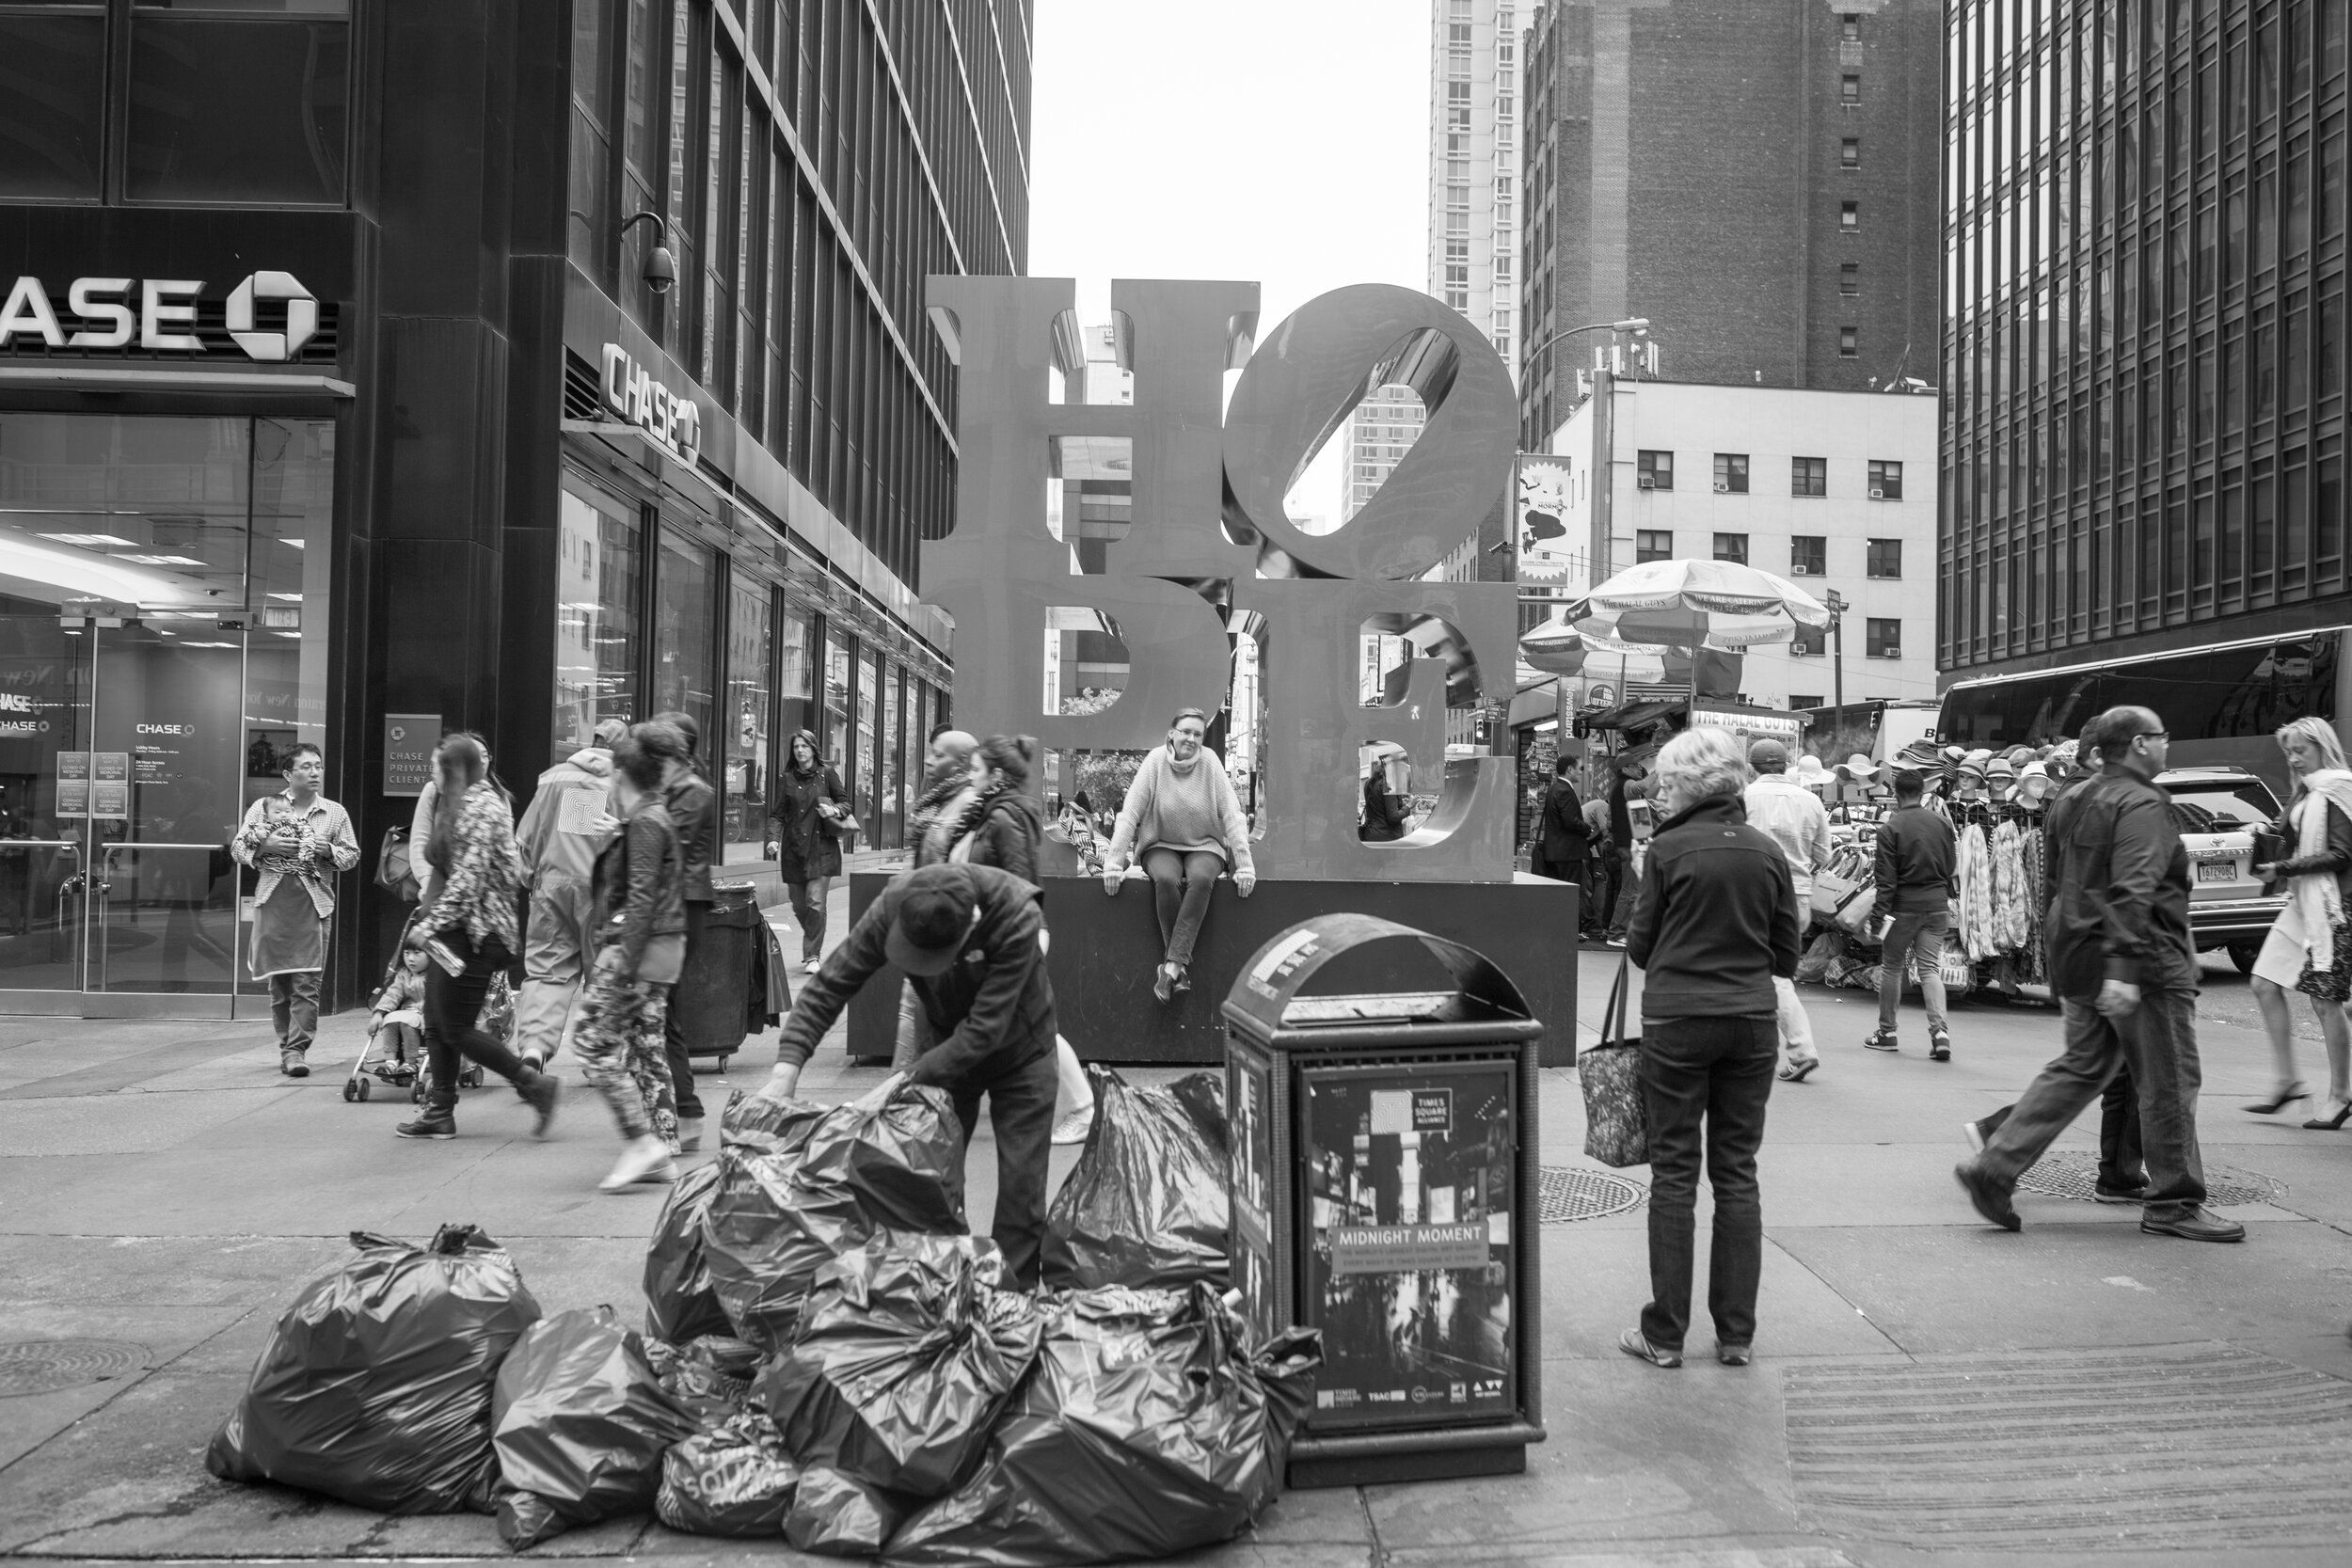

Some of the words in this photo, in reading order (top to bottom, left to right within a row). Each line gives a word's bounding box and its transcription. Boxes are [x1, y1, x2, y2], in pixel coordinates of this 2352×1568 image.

[603, 342, 678, 453] CHASE
[1645, 598, 1666, 608] GUYS
[1694, 594, 1708, 602] WE
[1709, 595, 1726, 604] ARE
[1727, 596, 1769, 607] CATERING
[1565, 684, 1575, 738] Newsstand
[1696, 711, 1719, 725] THE
[1723, 713, 1760, 729] HALAL
[1764, 717, 1796, 731] GUYS
[136, 724, 182, 734] CHASE
[389, 752, 423, 761] CHASE
[390, 764, 436, 772] PRIVATE
[1418, 1098, 1445, 1108] TIMES
[1415, 1107, 1448, 1117] SQUARE
[1417, 1116, 1446, 1124] ALLIANCE
[1339, 1228, 1412, 1246] MIDNIGHT
[1417, 1226, 1483, 1243] MOMENT
